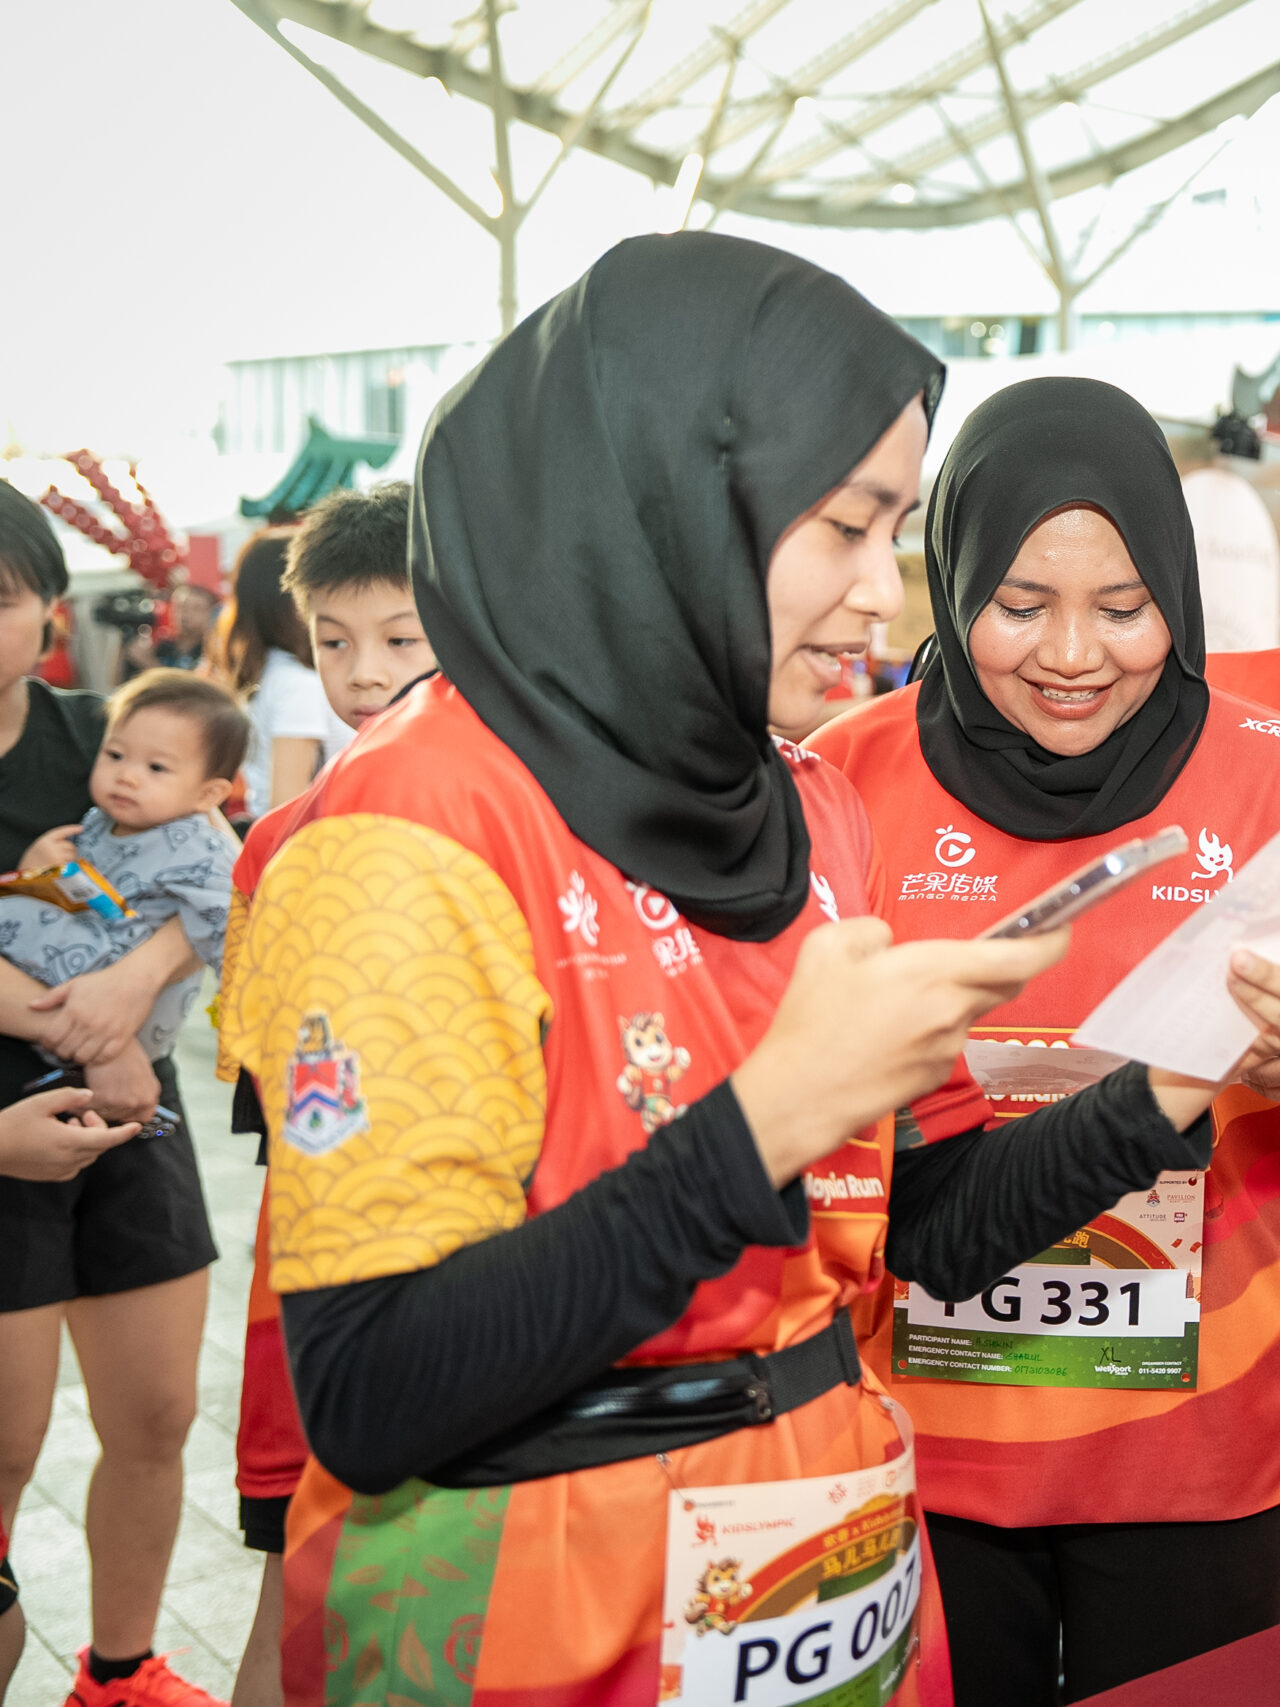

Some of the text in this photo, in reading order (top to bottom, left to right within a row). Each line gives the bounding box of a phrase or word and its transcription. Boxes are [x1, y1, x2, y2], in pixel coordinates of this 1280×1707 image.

[901, 871, 999, 895] 芒果传媒
[845, 1173, 885, 1199] Run
[1040, 1280, 1141, 1327] 331
[909, 1333, 973, 1346] PARTICIPANT NAME:
[908, 1345, 1004, 1360] EMERGENCY CONTACT NAME:
[1100, 1346, 1122, 1365] XL
[908, 1357, 1013, 1373] EMERGENCY CONTACT NUMBER:
[733, 1619, 834, 1703] PG
[850, 1553, 917, 1661] 007
